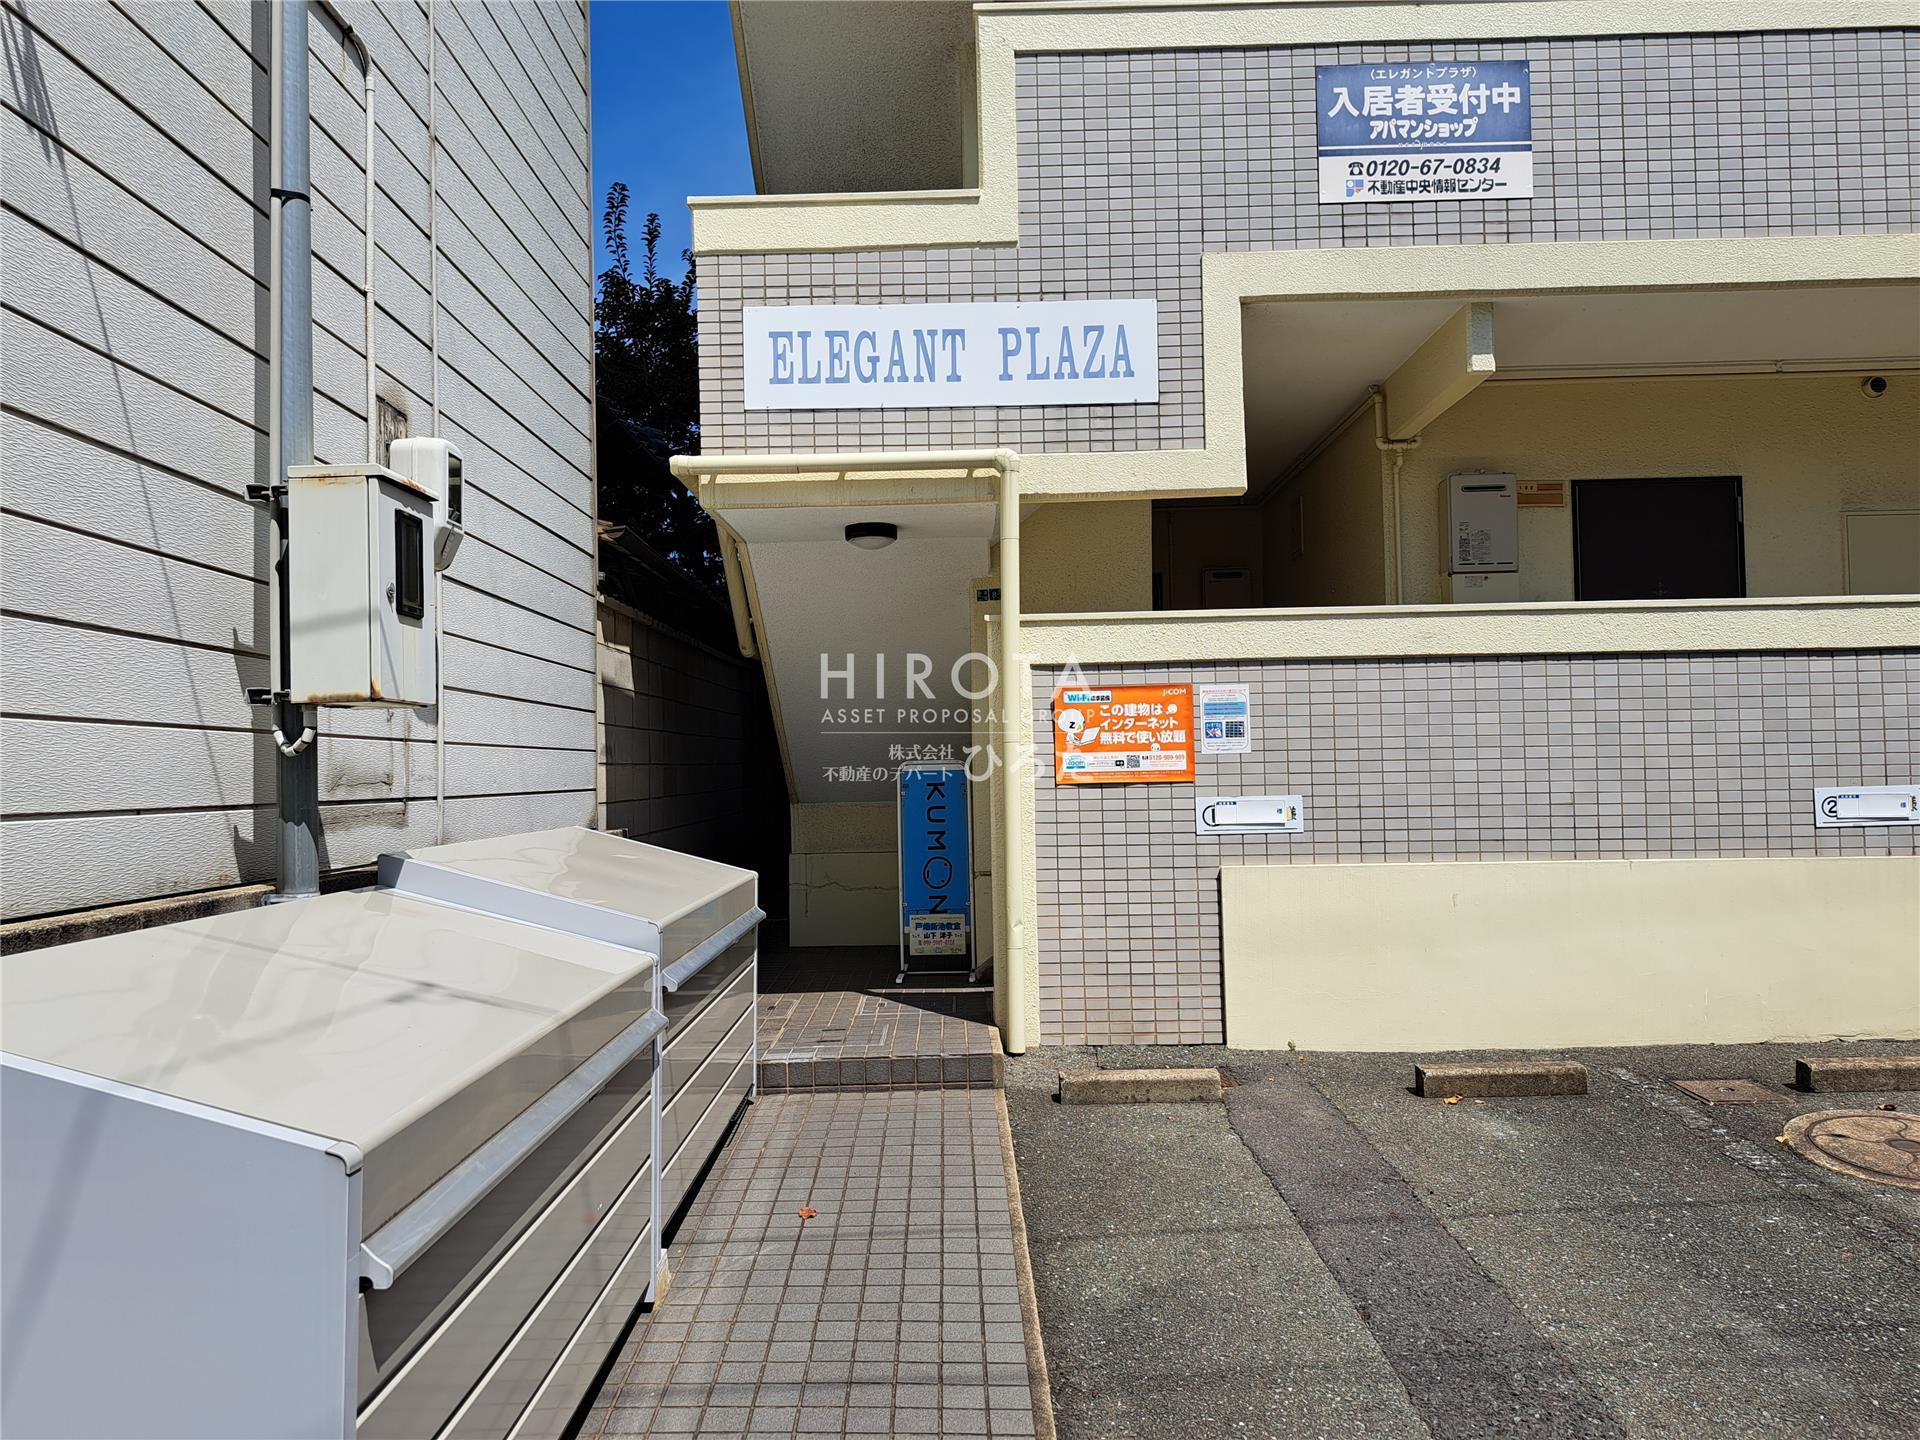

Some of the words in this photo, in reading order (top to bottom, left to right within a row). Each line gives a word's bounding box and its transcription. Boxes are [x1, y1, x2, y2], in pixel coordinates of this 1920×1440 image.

[1328, 82, 1521, 118] 入居者受付中
[1369, 117, 1478, 139] アパマンショップ
[1365, 157, 1501, 177] 0120-67-0834
[1367, 177, 1507, 196] 不動産中央情報センター
[768, 328, 966, 385] ELEGANT
[997, 324, 1135, 381] PLAZA
[1099, 703, 1163, 717] この建物は
[1100, 717, 1179, 731] インターネット
[1100, 730, 1187, 745] 無料で使い放題
[923, 782, 953, 915] KUMON
